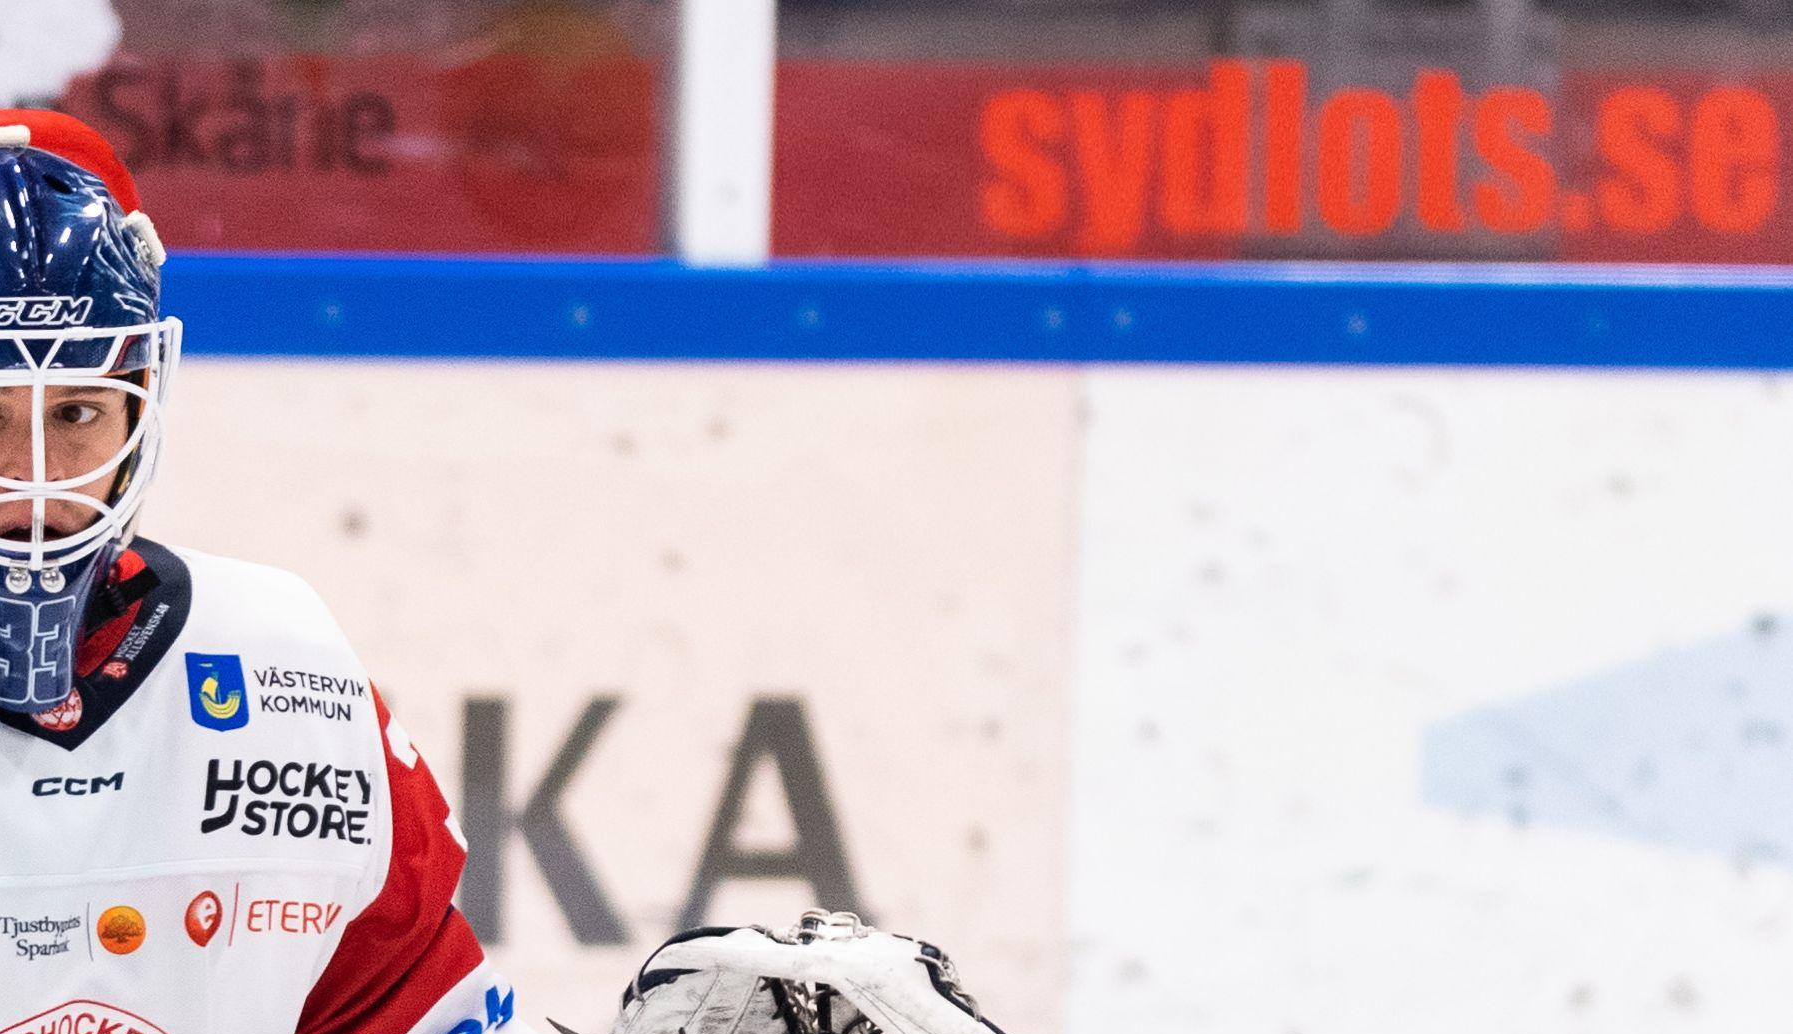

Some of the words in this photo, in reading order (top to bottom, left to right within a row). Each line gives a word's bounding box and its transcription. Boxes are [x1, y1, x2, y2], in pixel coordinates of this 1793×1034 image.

[977, 58, 1782, 255] sydlots.se
[254, 667, 370, 701] VÄSTERVIK
[260, 695, 352, 722] KOMMUN
[32, 772, 125, 797] CCM
[201, 758, 372, 820] HOCKEY
